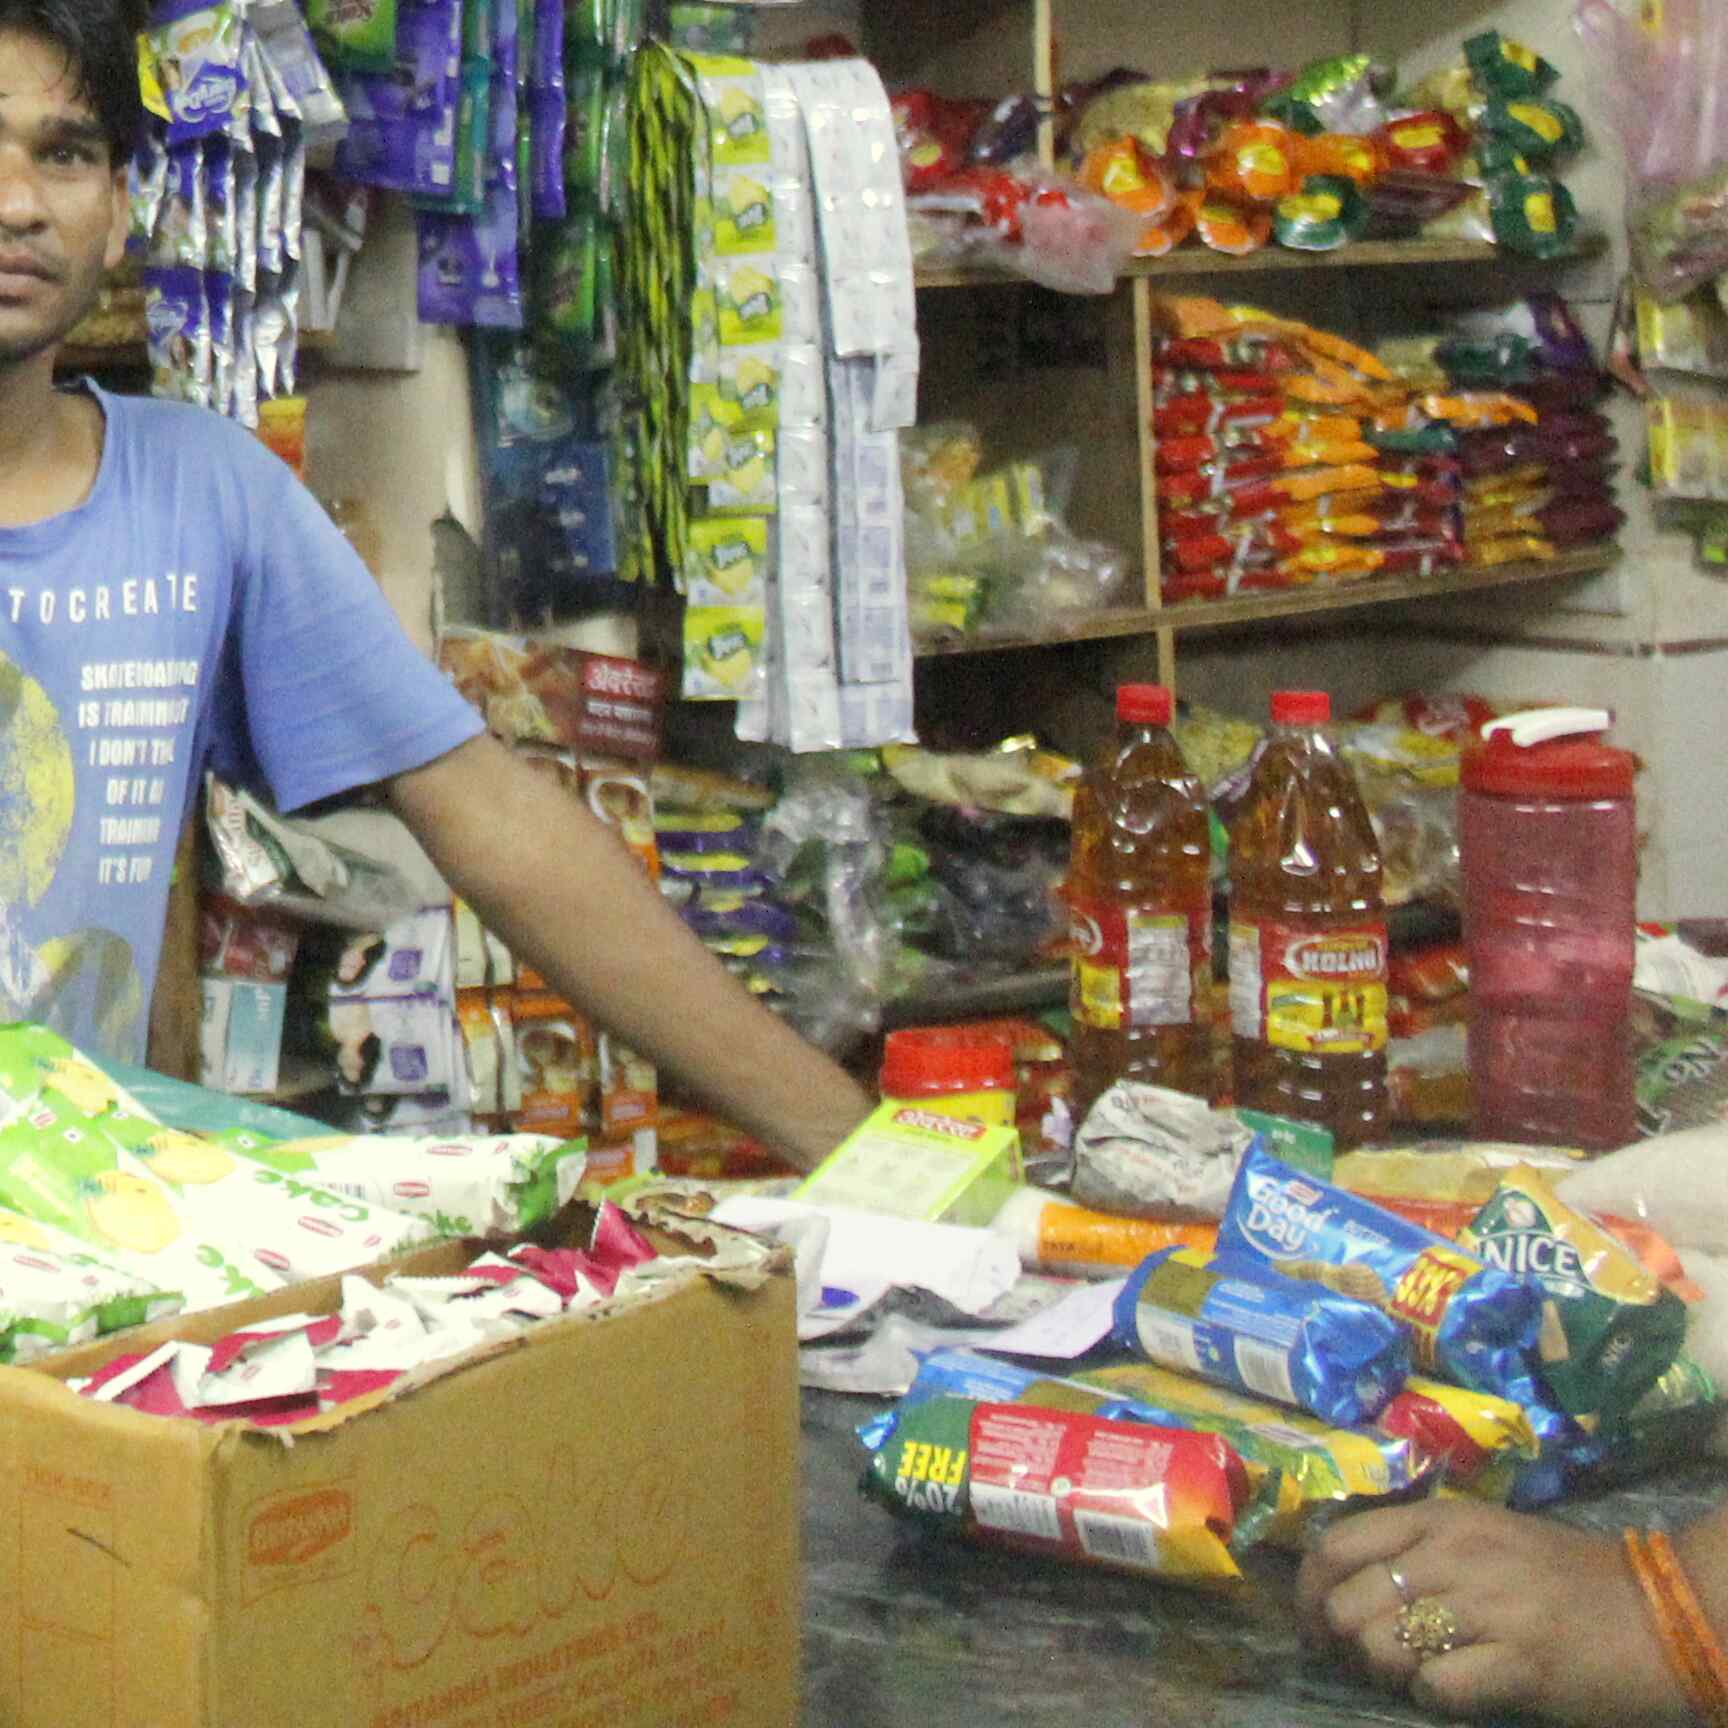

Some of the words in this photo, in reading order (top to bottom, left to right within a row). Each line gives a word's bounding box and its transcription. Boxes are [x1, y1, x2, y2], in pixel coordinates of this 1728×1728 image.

[8, 588, 54, 624] TO
[69, 574, 198, 623] CREATE
[79, 702, 100, 728] IS
[1247, 1170, 1329, 1225] Good
[1246, 1203, 1309, 1253] Day
[1484, 1235, 1576, 1273] NICE
[899, 1440, 967, 1486] FREE
